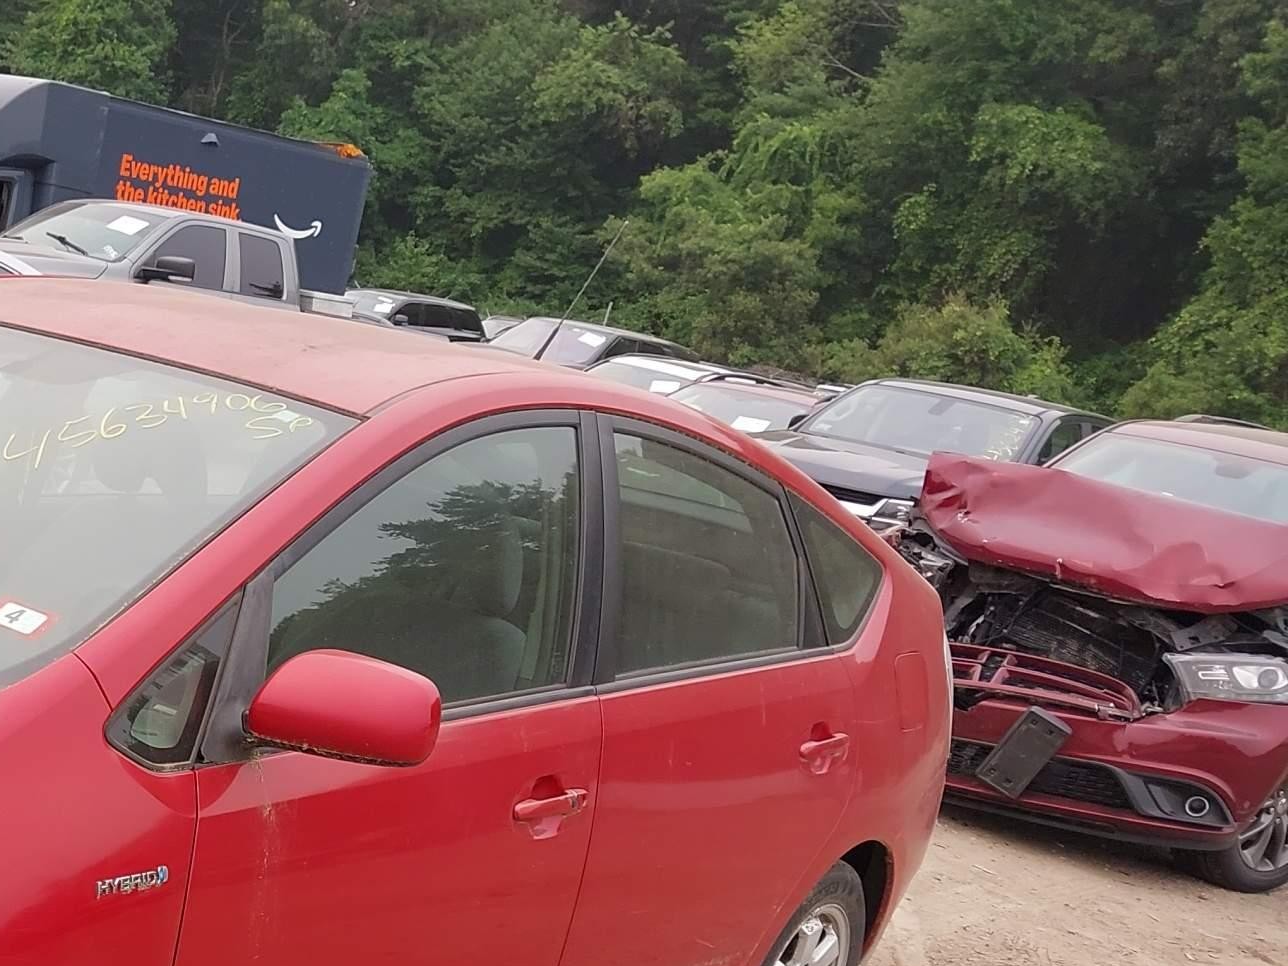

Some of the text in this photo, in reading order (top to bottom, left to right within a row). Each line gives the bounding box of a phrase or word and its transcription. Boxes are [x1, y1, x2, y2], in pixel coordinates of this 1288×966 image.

[119, 153, 240, 199] Everything and
[115, 180, 145, 204] the
[147, 185, 206, 213] kitchen
[2, 392, 288, 469] 45634906
[4, 609, 27, 624] 4
[96, 869, 158, 900] HYBRID
